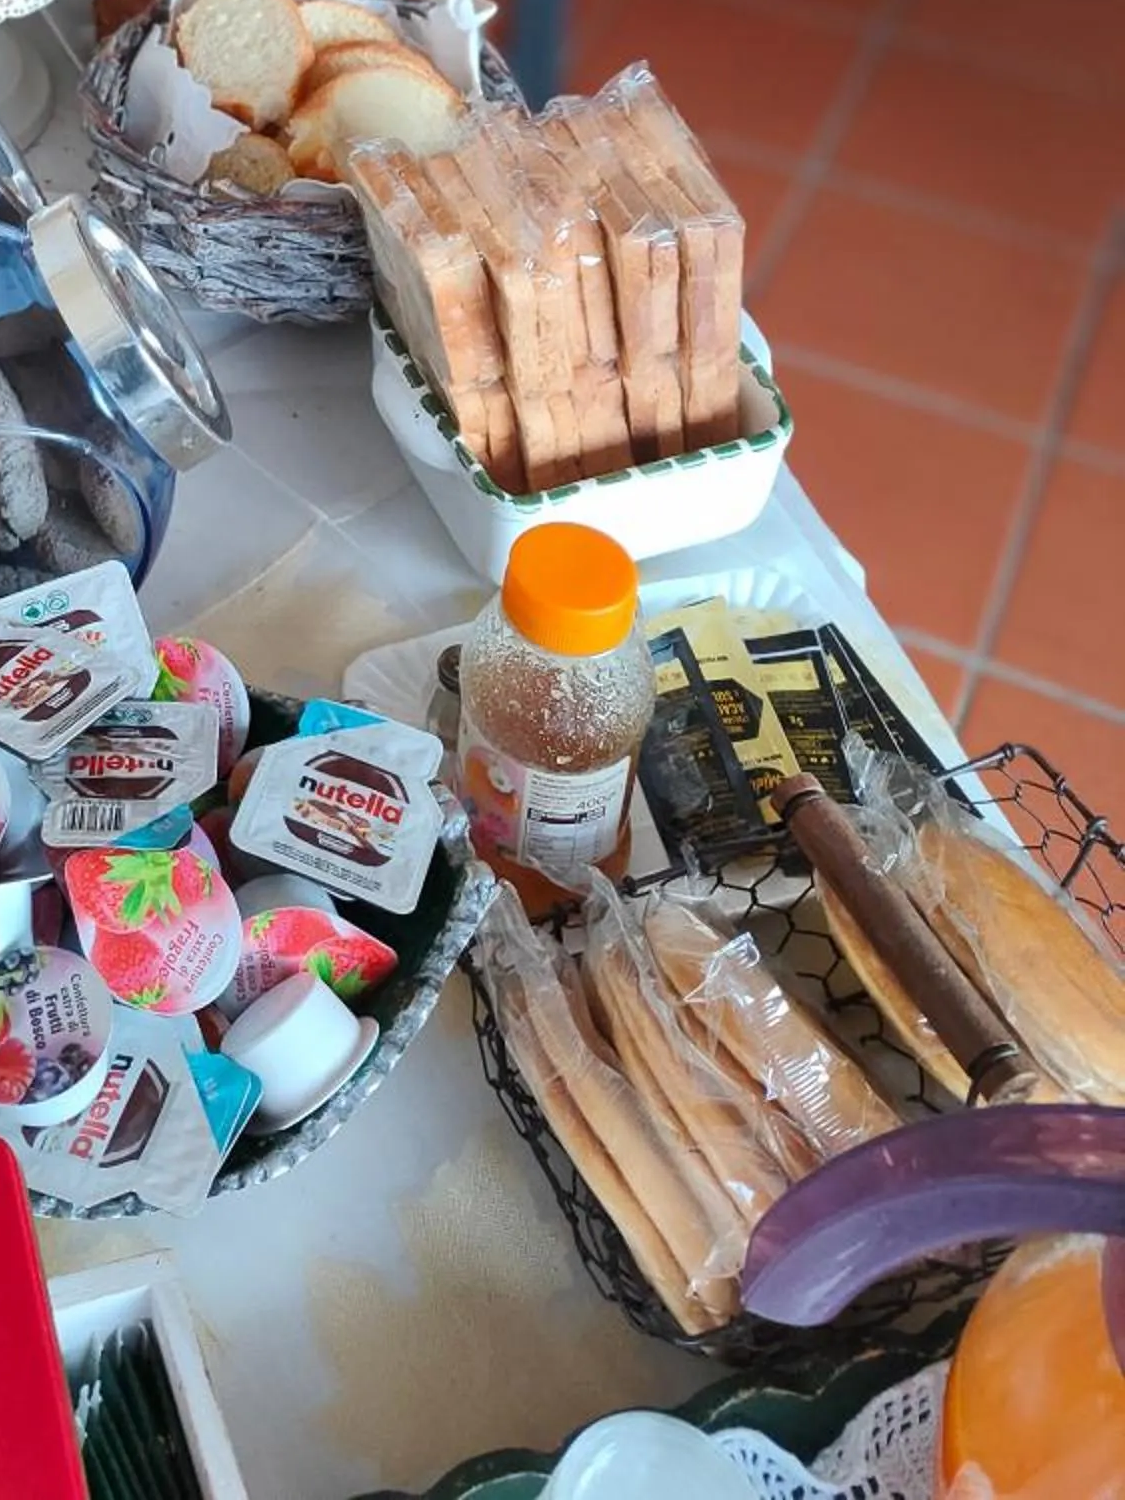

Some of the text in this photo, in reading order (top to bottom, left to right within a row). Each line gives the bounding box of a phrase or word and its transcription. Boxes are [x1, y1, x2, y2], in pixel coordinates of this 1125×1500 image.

[299, 773, 406, 825] nutella
[160, 920, 199, 977] Fragole
[185, 933, 224, 992] Confettura
[26, 988, 47, 1050] di Bosco
[44, 993, 63, 1035] Frutti
[69, 974, 91, 1037] Confettura
[69, 1053, 135, 1160] nutella
